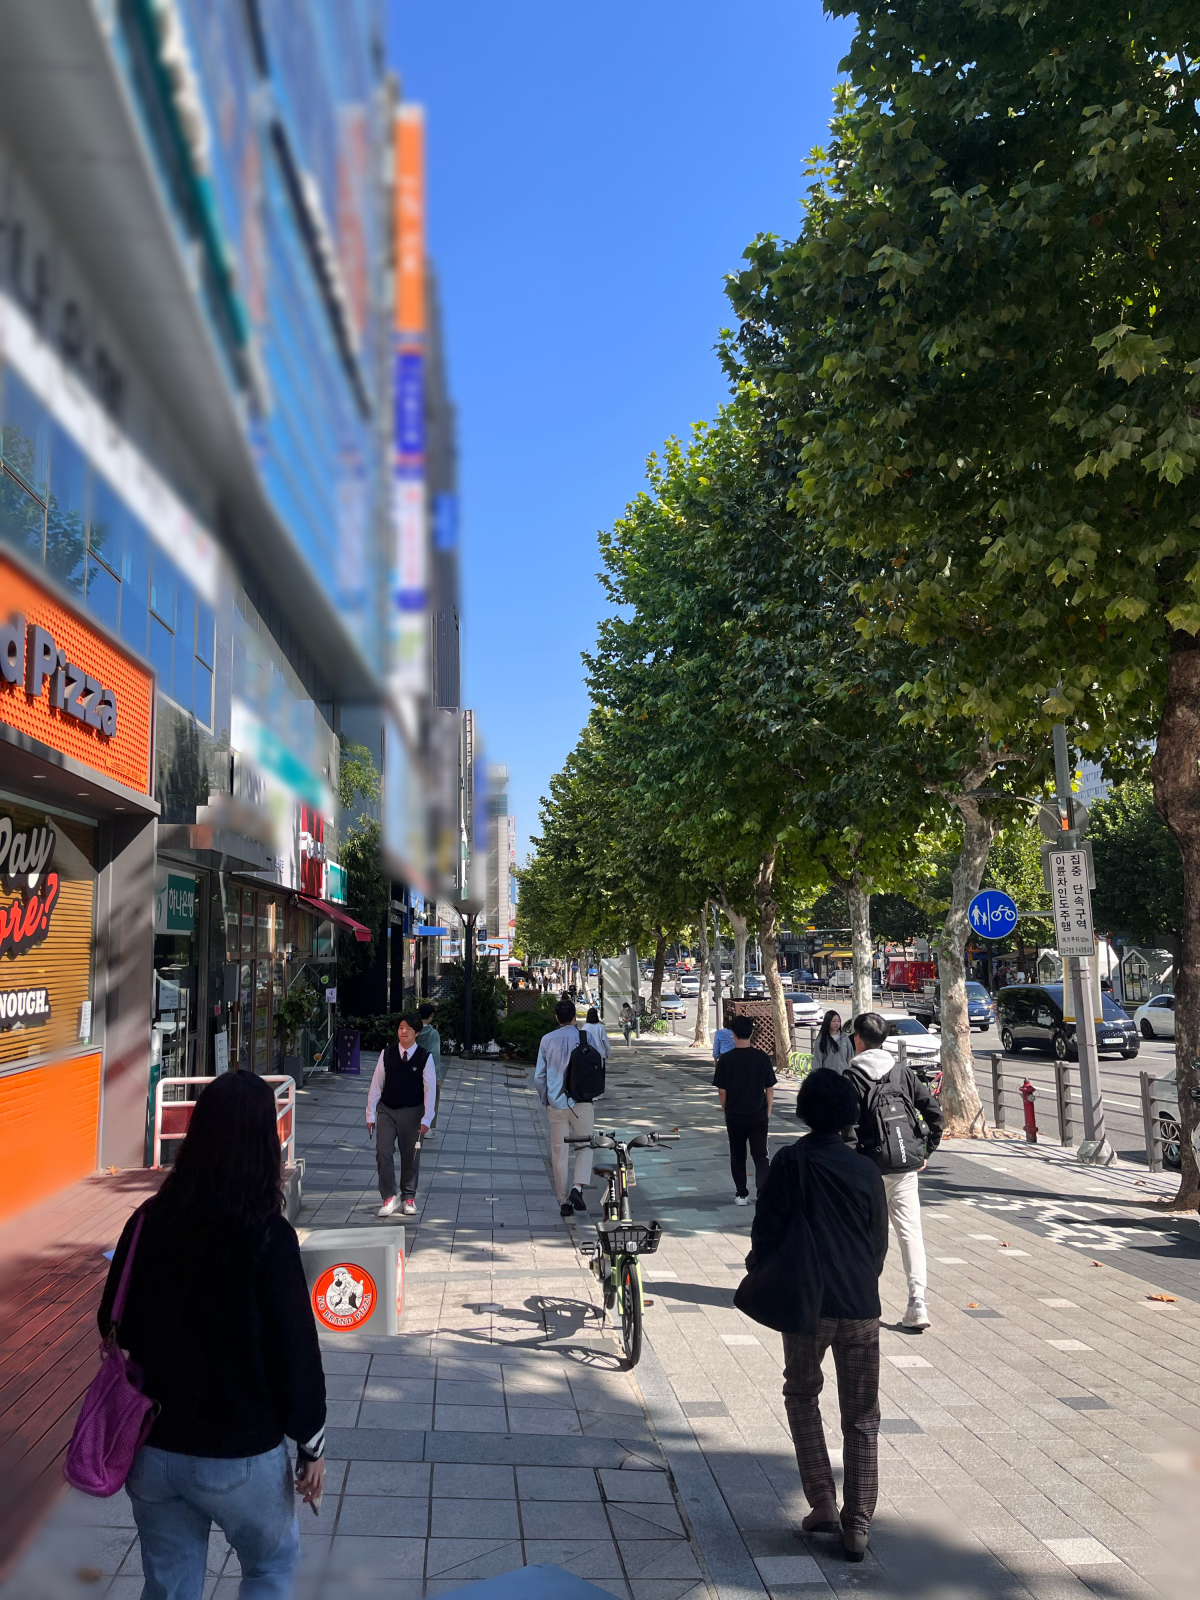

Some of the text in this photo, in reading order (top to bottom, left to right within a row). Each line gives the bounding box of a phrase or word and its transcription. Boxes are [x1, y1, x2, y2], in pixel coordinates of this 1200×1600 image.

[27, 624, 117, 738] Pizza
[168, 888, 194, 919] 하나은행
[1056, 856, 1071, 932] 이륜차인도주행
[1070, 854, 1086, 929] 집중 단속구역
[898, 1139, 906, 1163] balance
[318, 1294, 370, 1324] NO BRAND PIZZA
